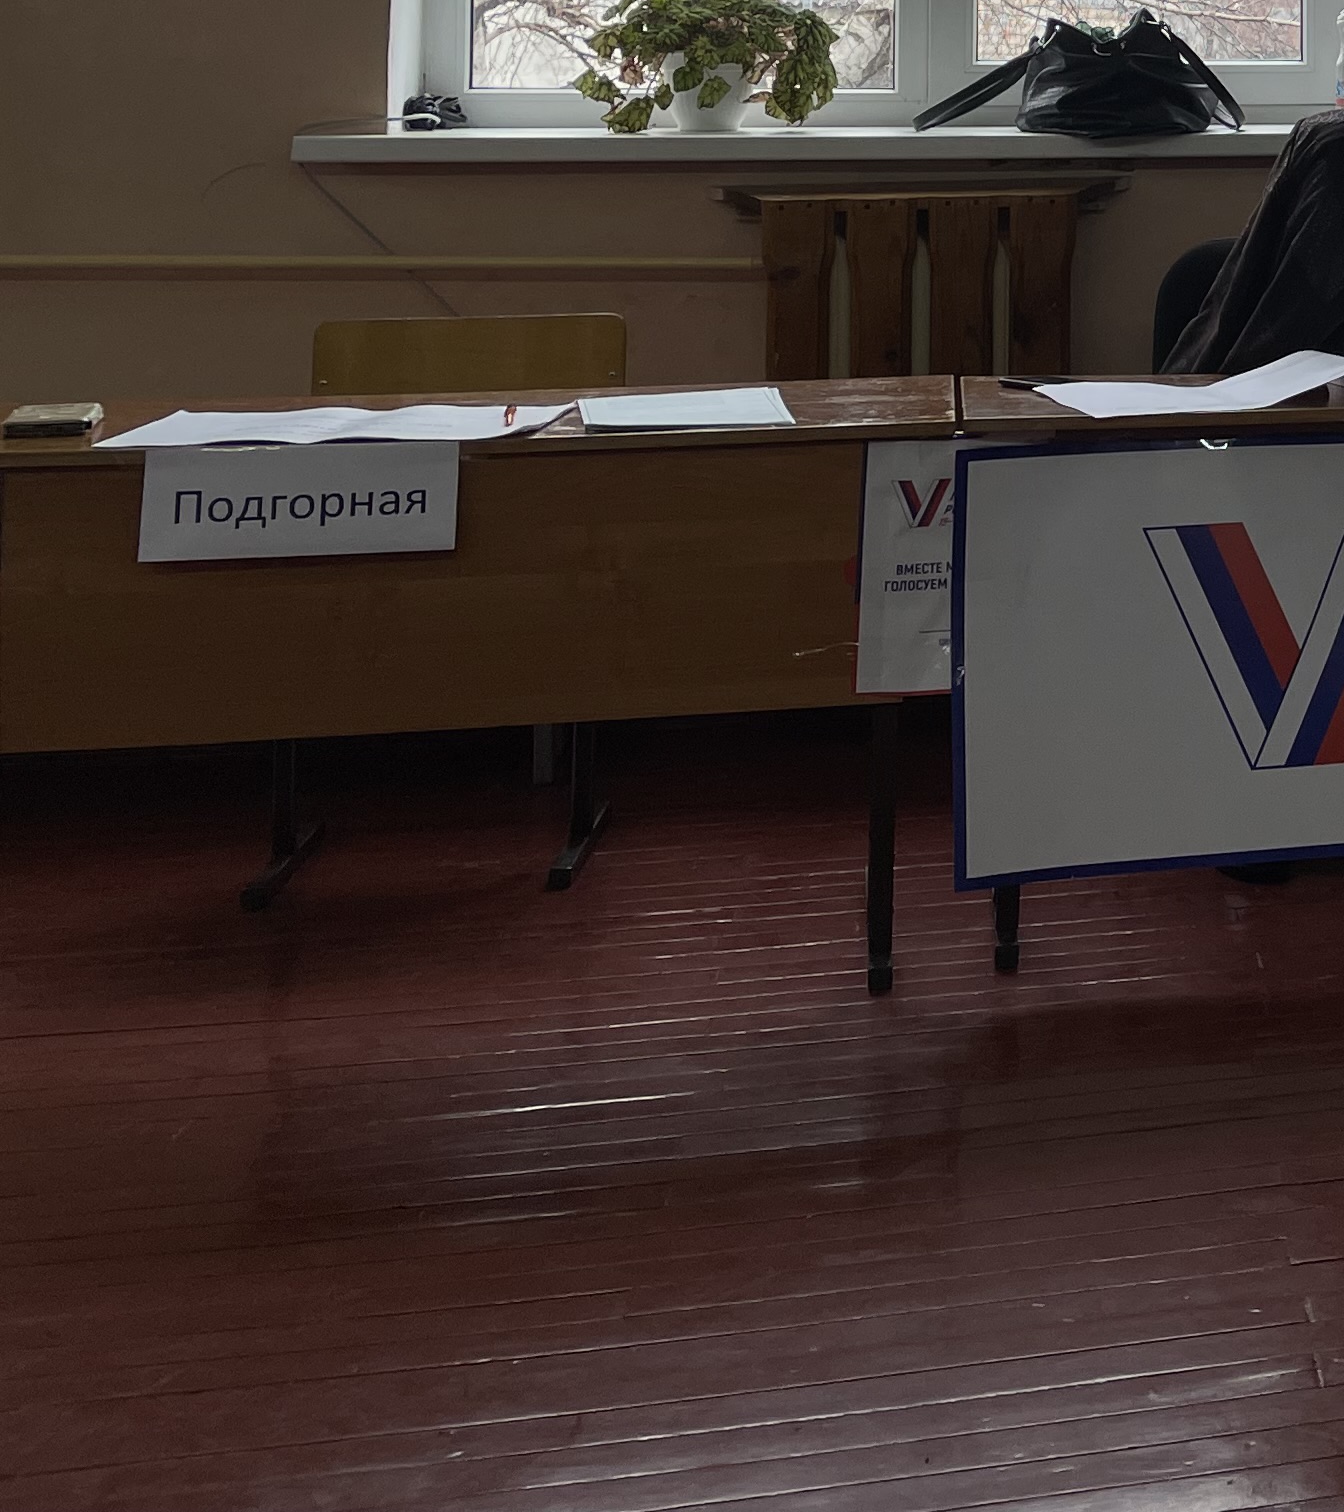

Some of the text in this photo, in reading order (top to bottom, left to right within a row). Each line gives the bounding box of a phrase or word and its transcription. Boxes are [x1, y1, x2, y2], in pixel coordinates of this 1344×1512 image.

[174, 488, 427, 529] Подгорная
[896, 562, 943, 576] ВМЕСТЕ
[884, 578, 948, 593] ГОЛОСУЕМ
